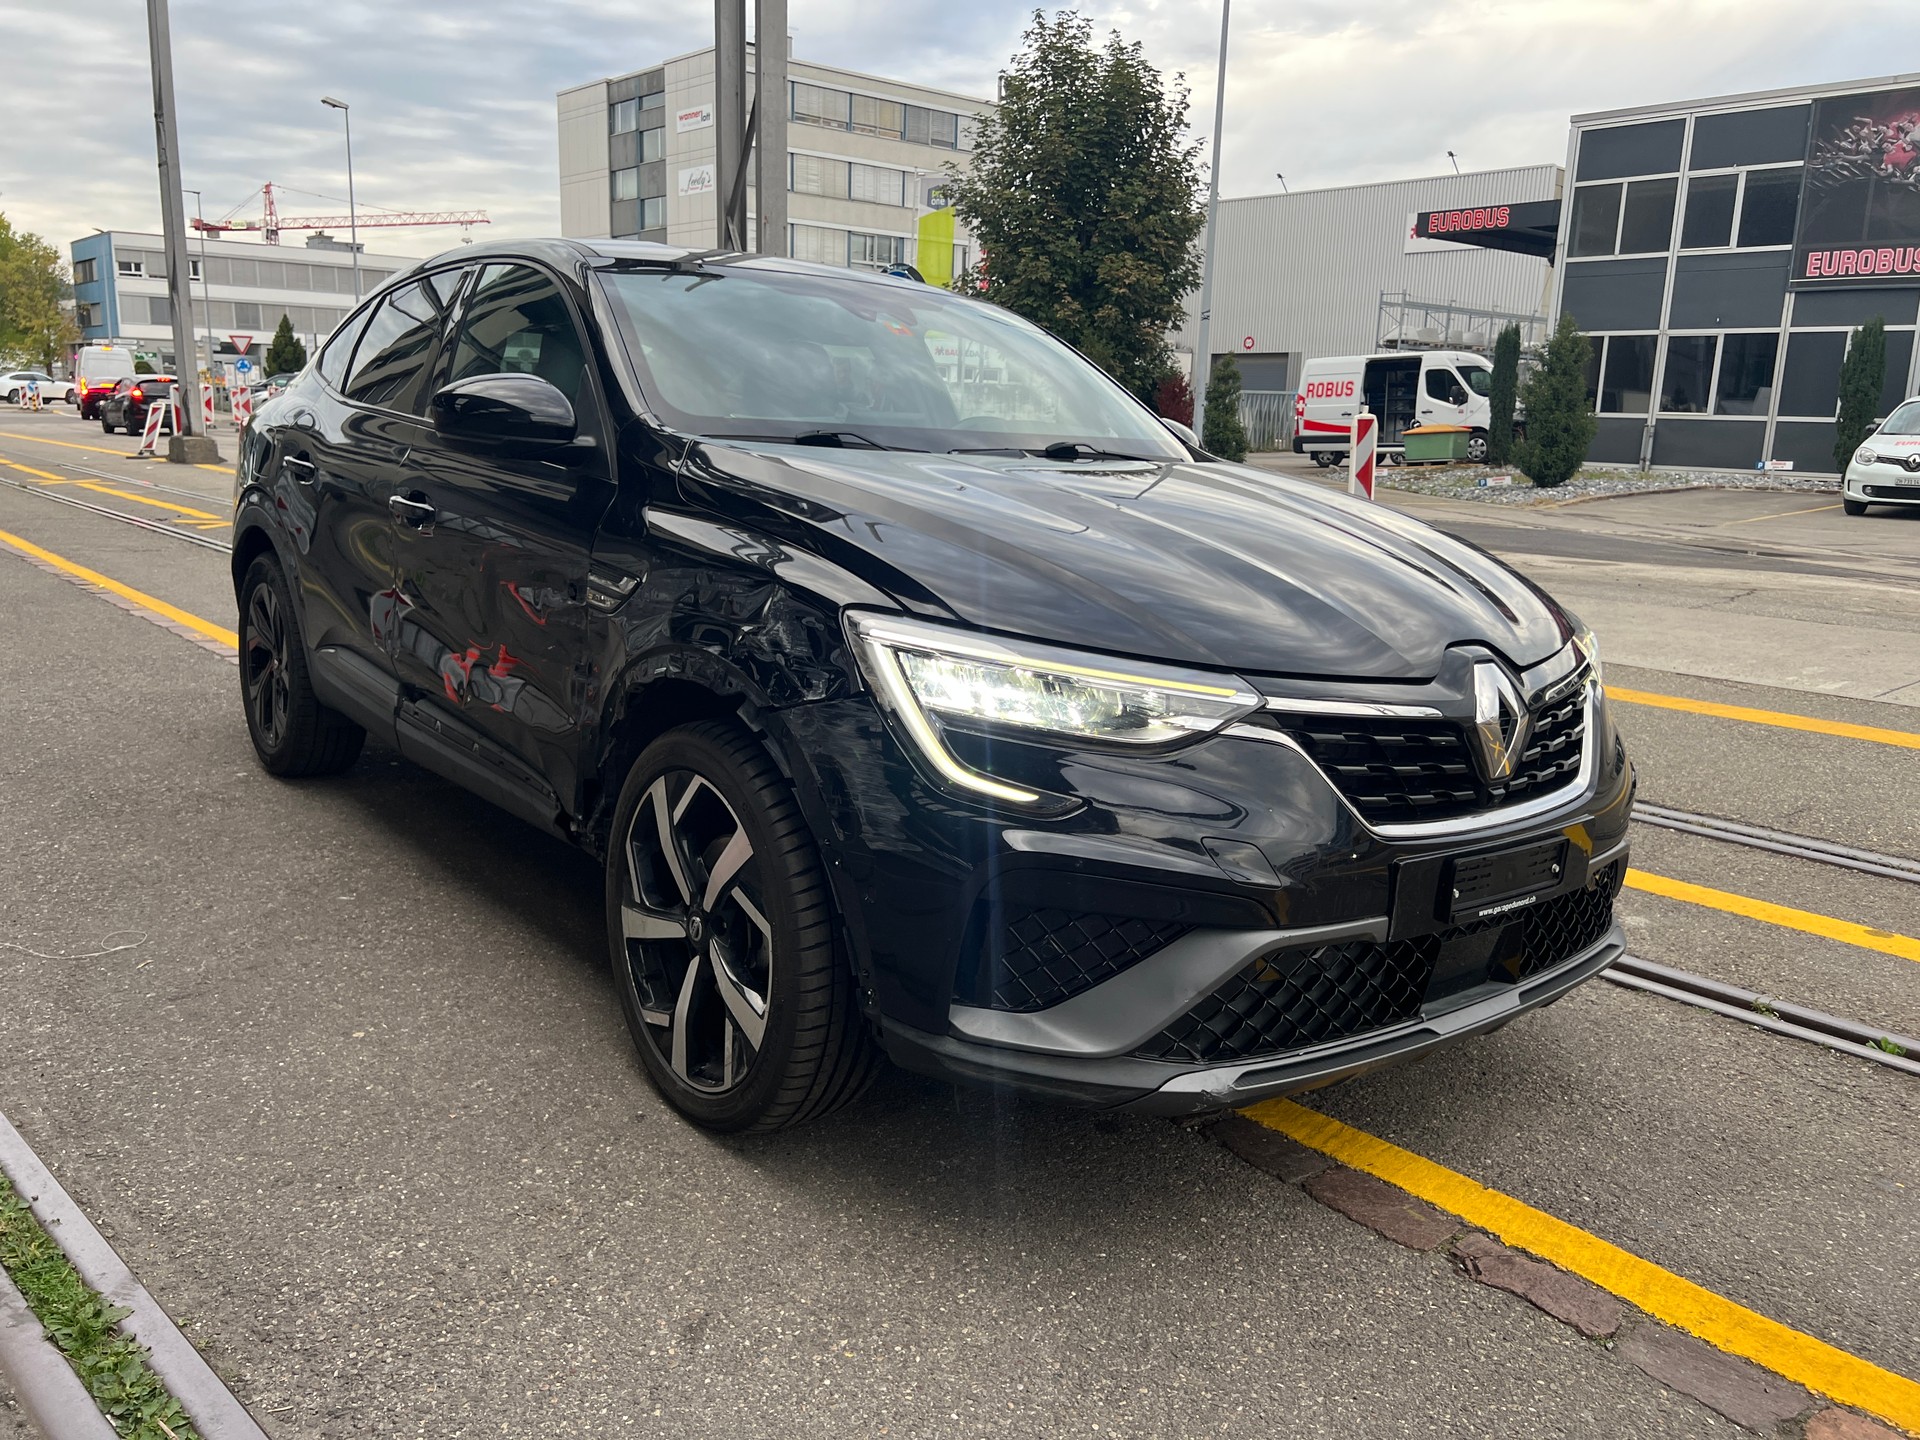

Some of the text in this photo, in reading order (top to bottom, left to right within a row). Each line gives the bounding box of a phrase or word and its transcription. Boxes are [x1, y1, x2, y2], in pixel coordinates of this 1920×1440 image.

[931, 198, 945, 206] one
[1428, 207, 1509, 232] EUROBUS
[1306, 381, 1354, 398] ROBUS
